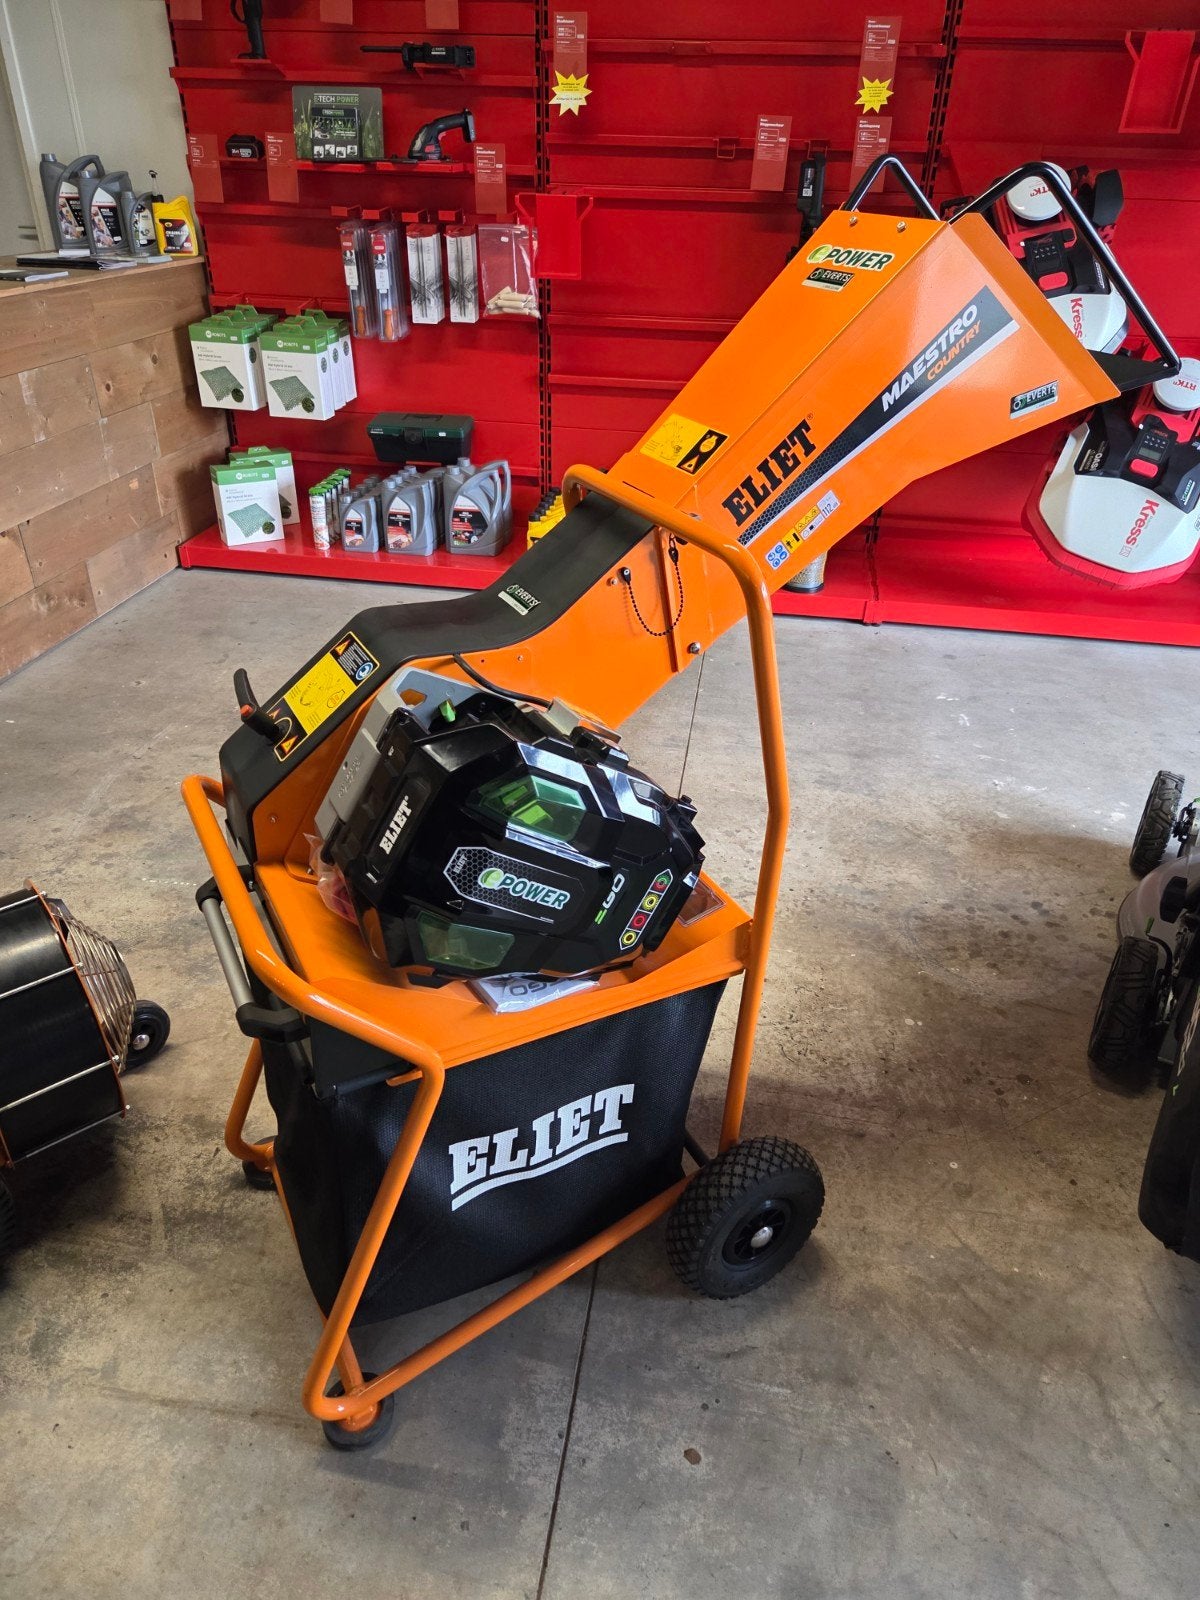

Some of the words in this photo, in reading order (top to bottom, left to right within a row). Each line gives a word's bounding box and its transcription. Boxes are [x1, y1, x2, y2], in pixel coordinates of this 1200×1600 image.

[336, 96, 359, 104] POWER
[822, 270, 851, 282] EVERTS
[1070, 297, 1083, 339] Kress
[881, 304, 978, 412] MAESTRO
[927, 319, 982, 381] COUNTRY
[1026, 382, 1058, 402] EVERTS
[721, 418, 817, 527] ELIET
[822, 503, 834, 516] 112
[1126, 499, 1160, 546] Kress
[515, 587, 538, 606] EVERTS
[379, 798, 412, 855] ELIET
[448, 1083, 635, 1195] ELIET
